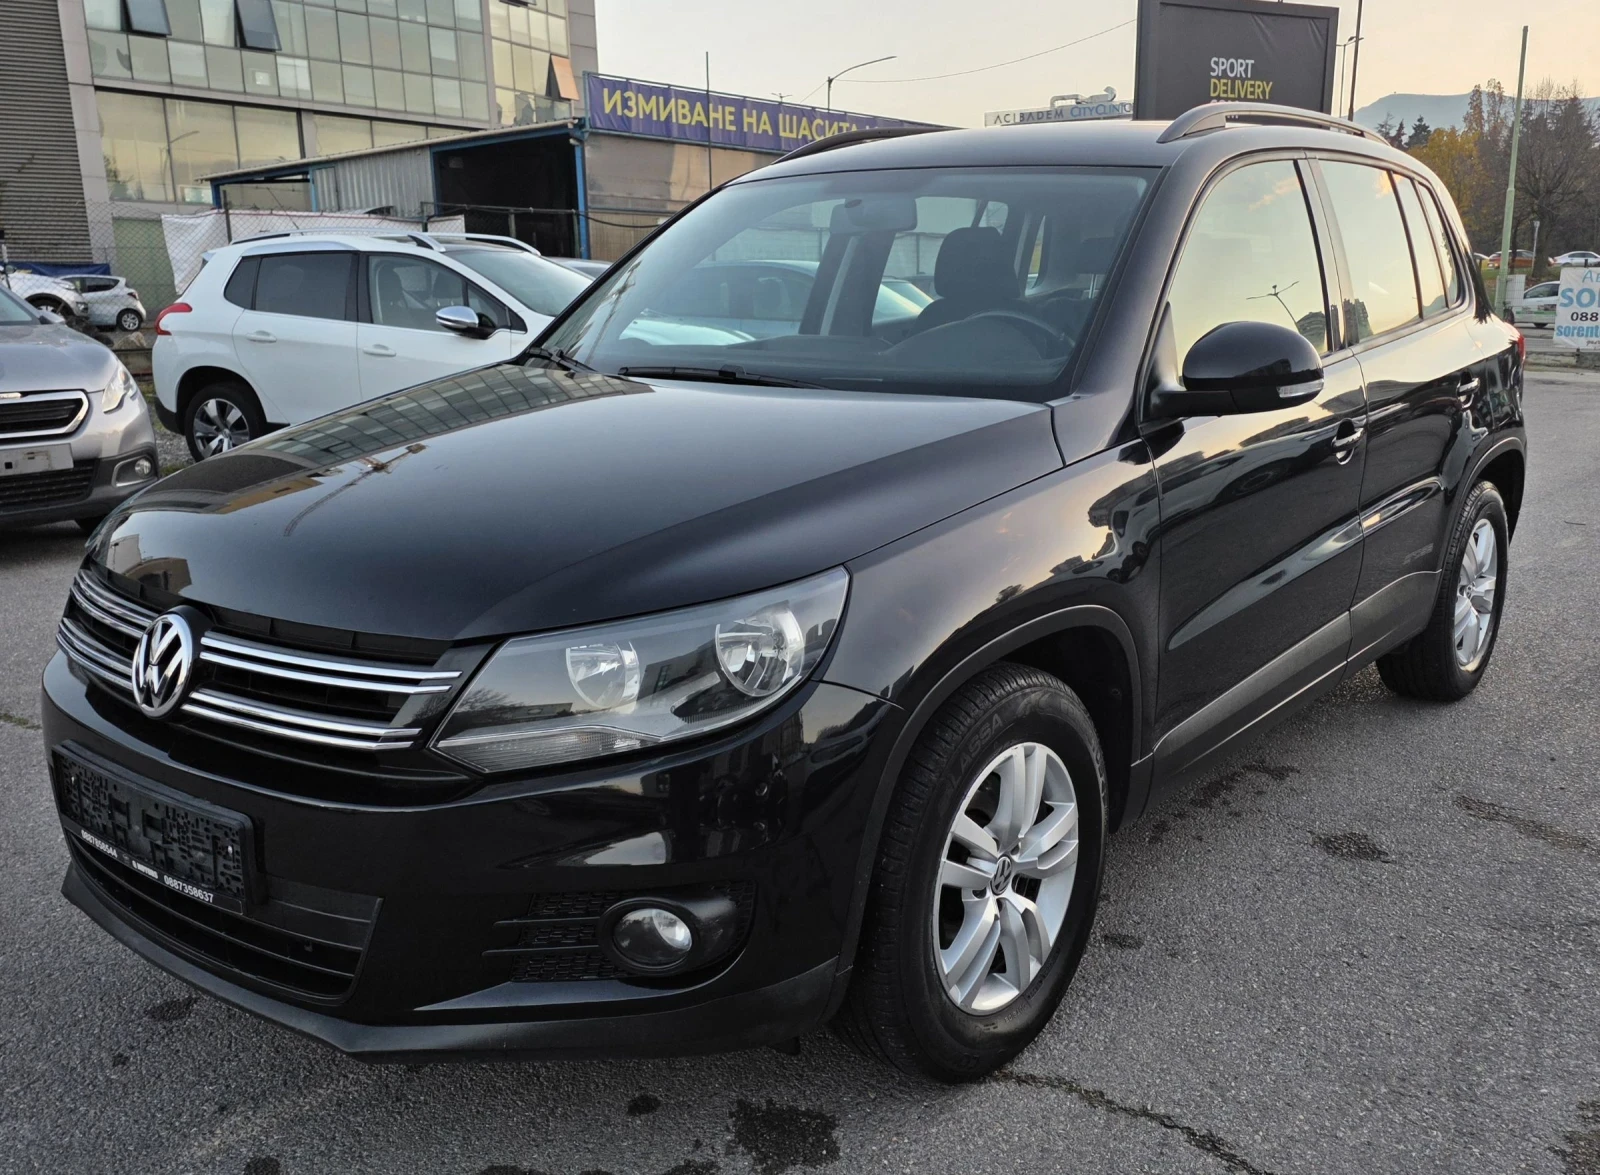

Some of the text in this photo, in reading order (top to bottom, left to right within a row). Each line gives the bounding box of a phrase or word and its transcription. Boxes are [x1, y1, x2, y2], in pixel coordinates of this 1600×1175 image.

[1210, 57, 1254, 79] SPORT
[1210, 78, 1273, 100] DELIVERY
[603, 87, 737, 132] ИЗМИВАНЕ
[743, 108, 773, 136] НА
[1559, 287, 1600, 307] SO
[1570, 312, 1599, 322] 088
[163, 874, 214, 903] 0887358637
